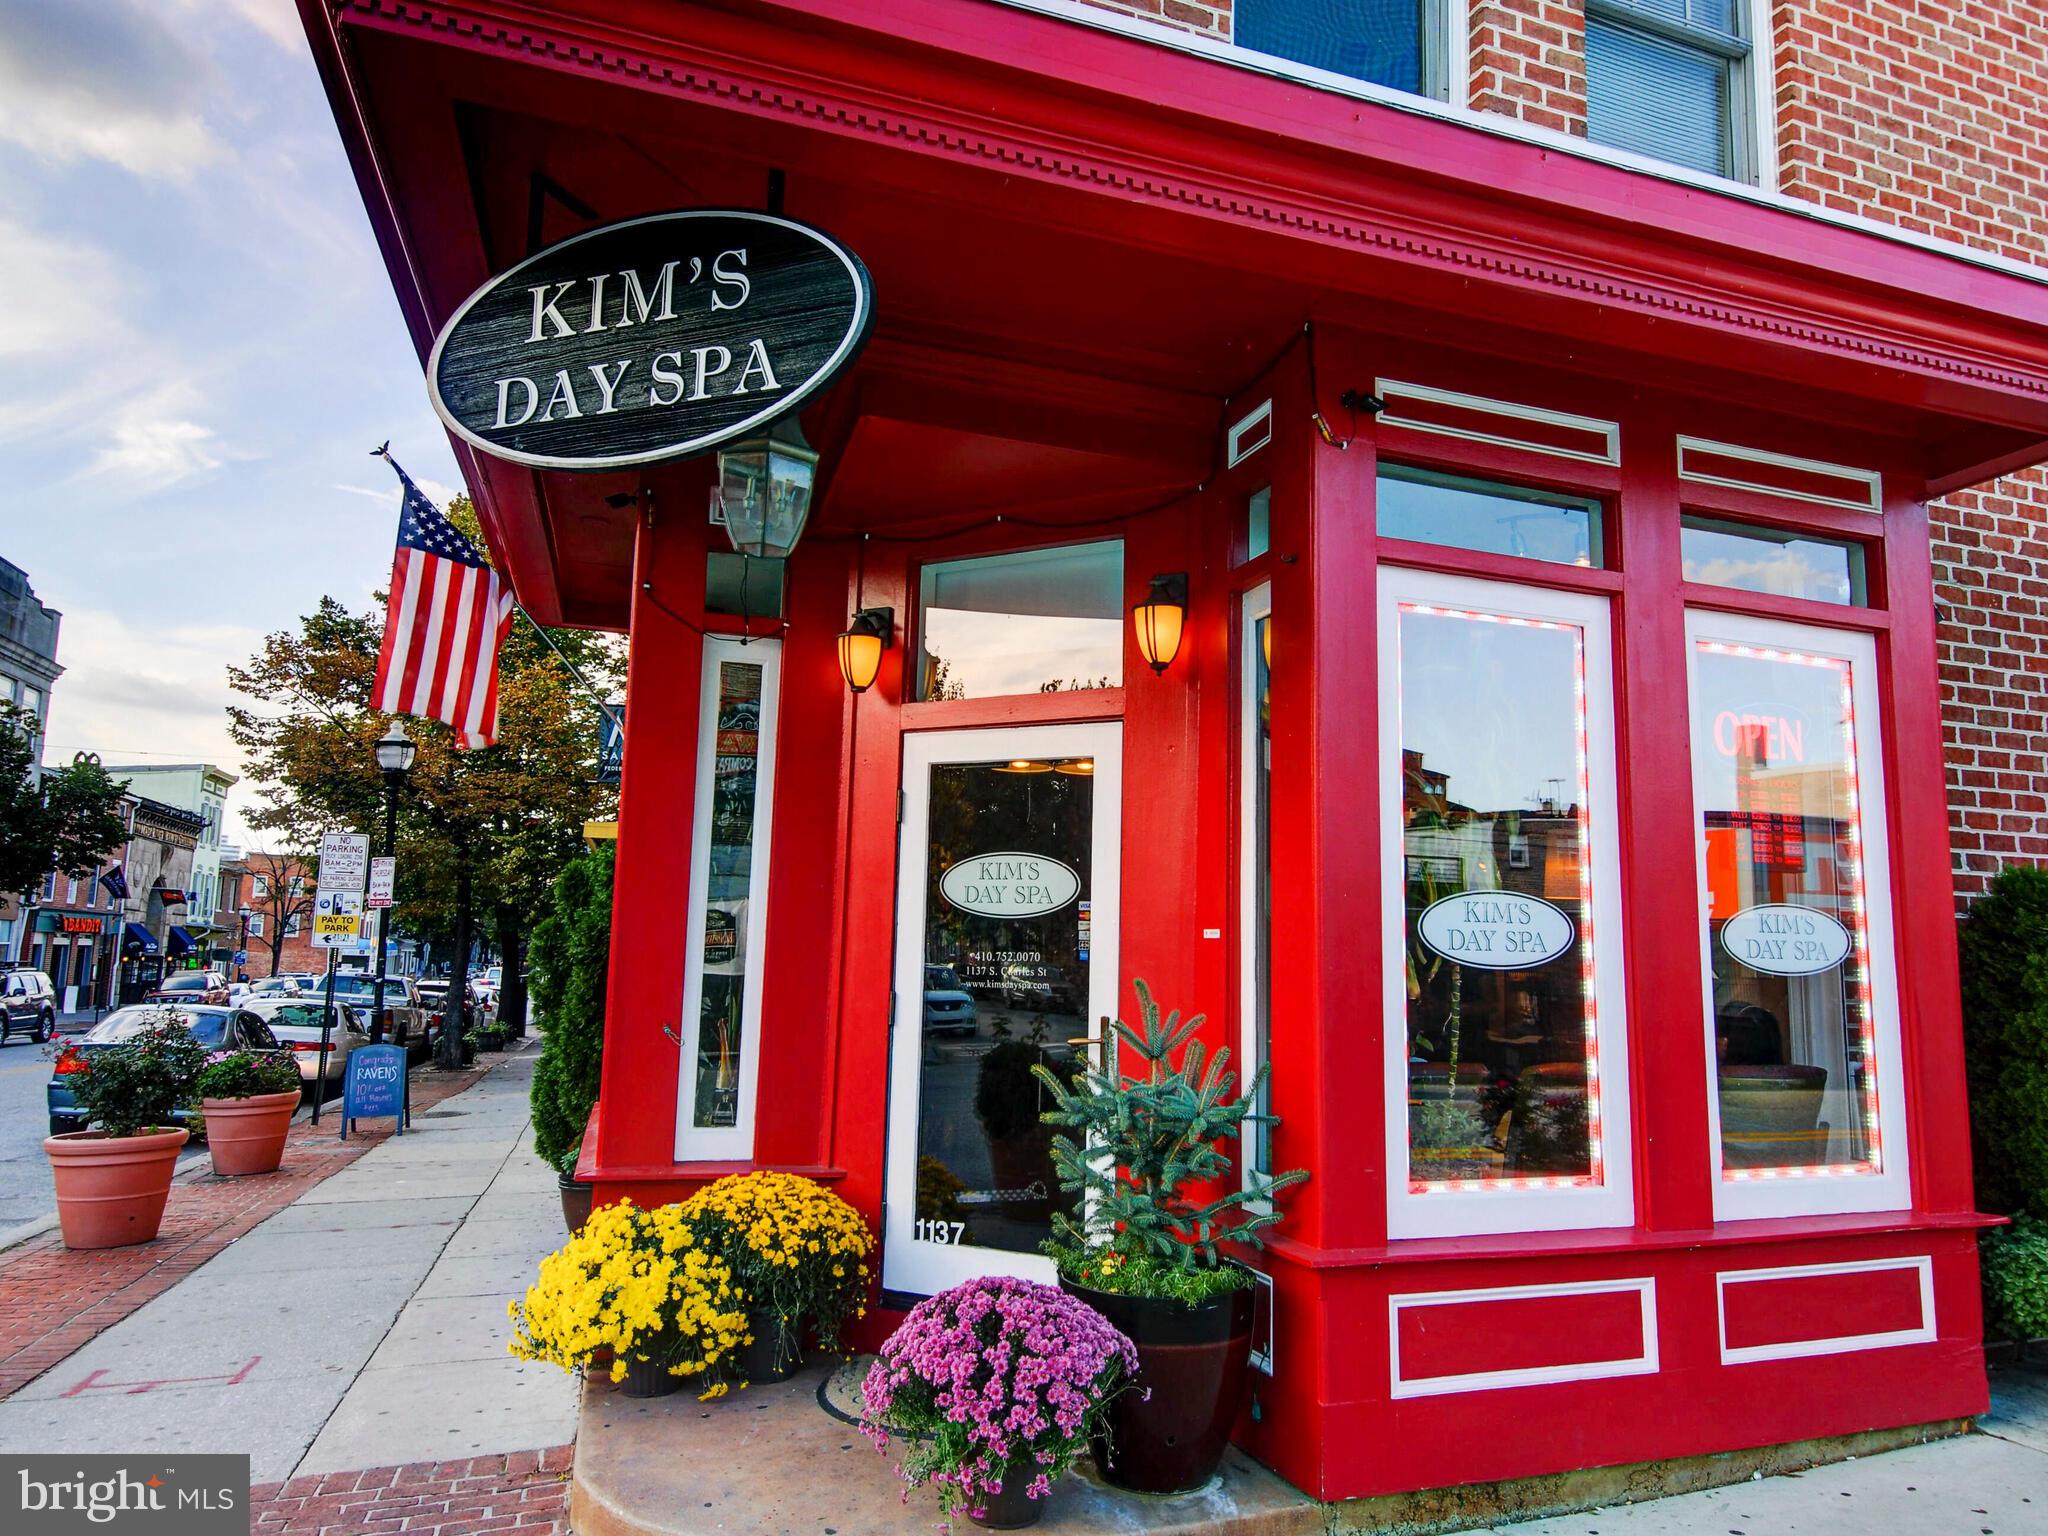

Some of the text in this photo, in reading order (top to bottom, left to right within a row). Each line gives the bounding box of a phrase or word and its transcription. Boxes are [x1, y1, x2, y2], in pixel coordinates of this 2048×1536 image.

[525, 249, 750, 344] KIM'S
[491, 338, 781, 429] DAY SPA
[1713, 711, 1804, 762] OPEN
[326, 845, 363, 854] PARKING
[979, 862, 1040, 880] KIM'S
[964, 885, 1054, 904] DAY SPA
[341, 916, 354, 924] TO
[1463, 901, 1531, 925] KIM'S
[1758, 913, 1816, 935] KIM'S
[1447, 929, 1548, 953] DAY SPA
[1745, 939, 1830, 961] DAY SPA
[974, 951, 1041, 962] 410.752.0070
[966, 966, 987, 976] 1137
[989, 966, 998, 976] S.
[1037, 967, 1047, 977] St
[965, 979, 1050, 991] www.kimsdayspa.com
[357, 1065, 397, 1082] RAVENS
[916, 1218, 965, 1246] 1137
